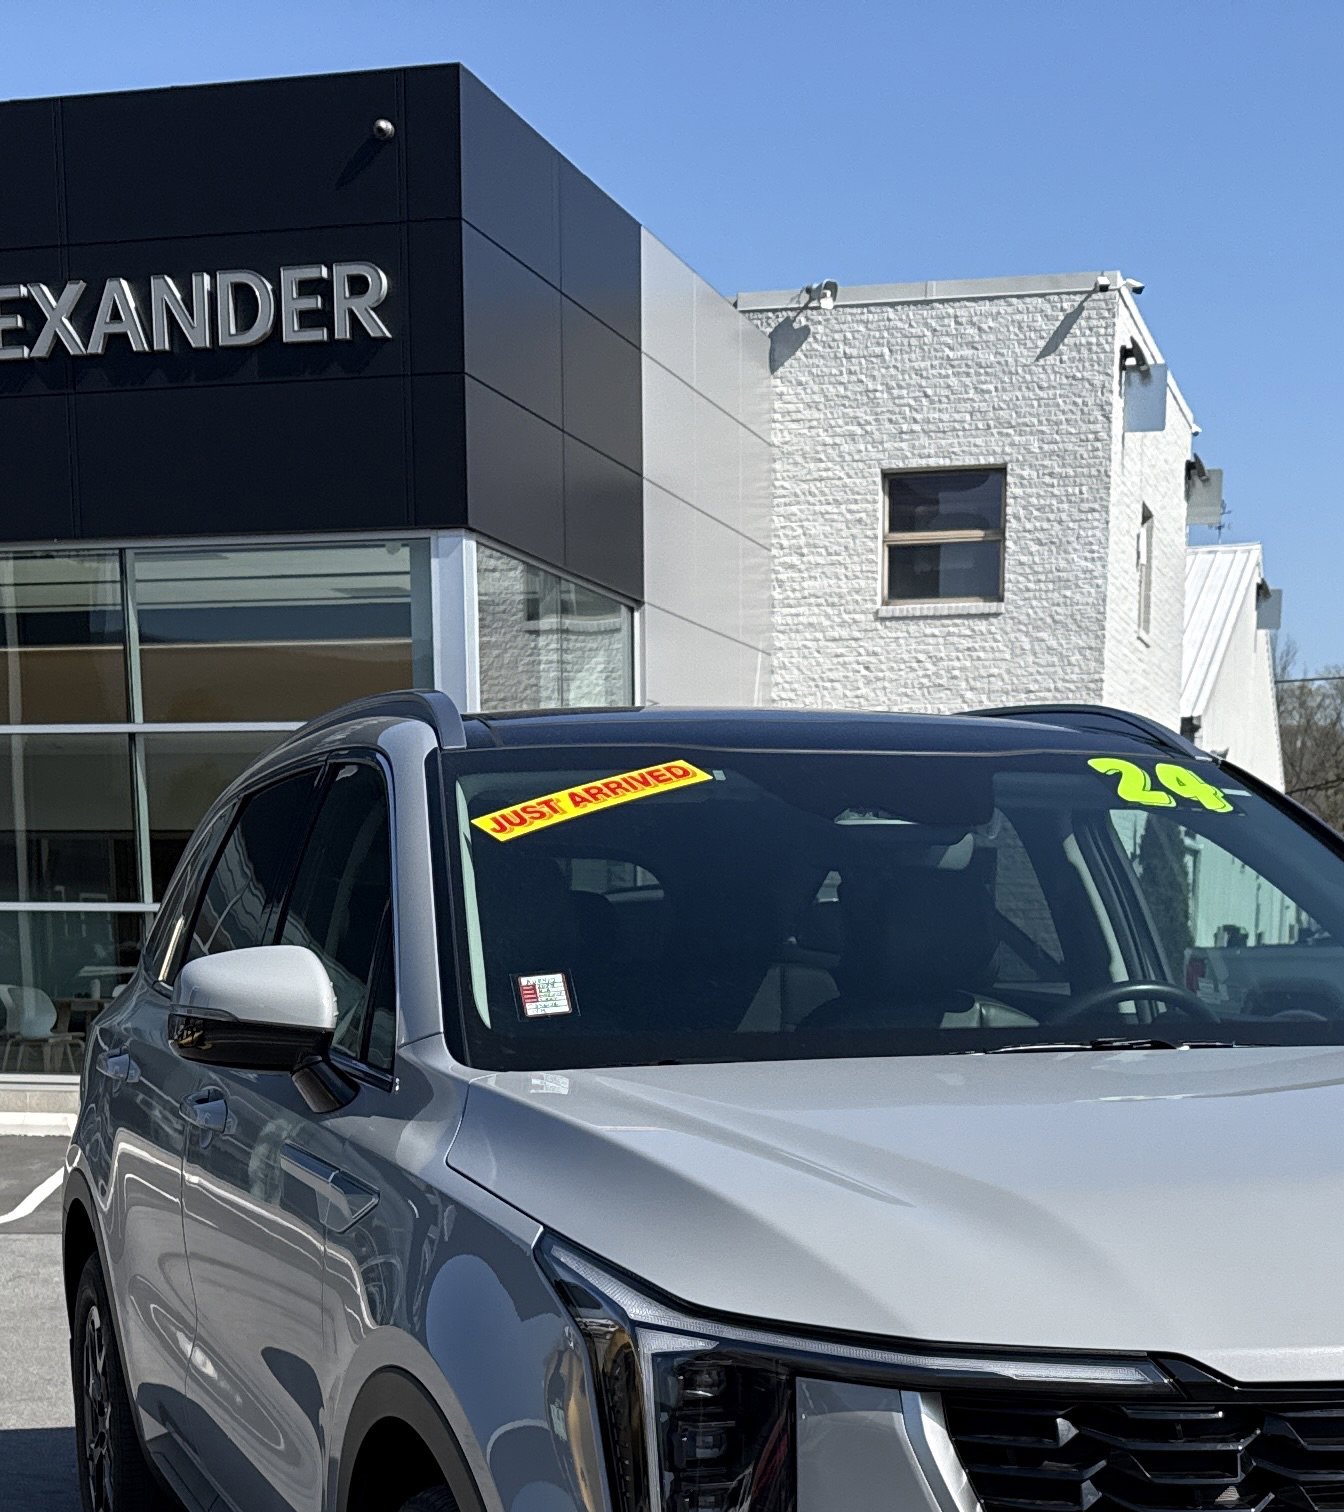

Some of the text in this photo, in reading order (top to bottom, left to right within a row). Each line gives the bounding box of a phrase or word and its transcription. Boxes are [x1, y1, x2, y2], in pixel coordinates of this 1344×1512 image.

[489, 764, 698, 836] JUST ARRIVED
[1087, 757, 1234, 813] 24
